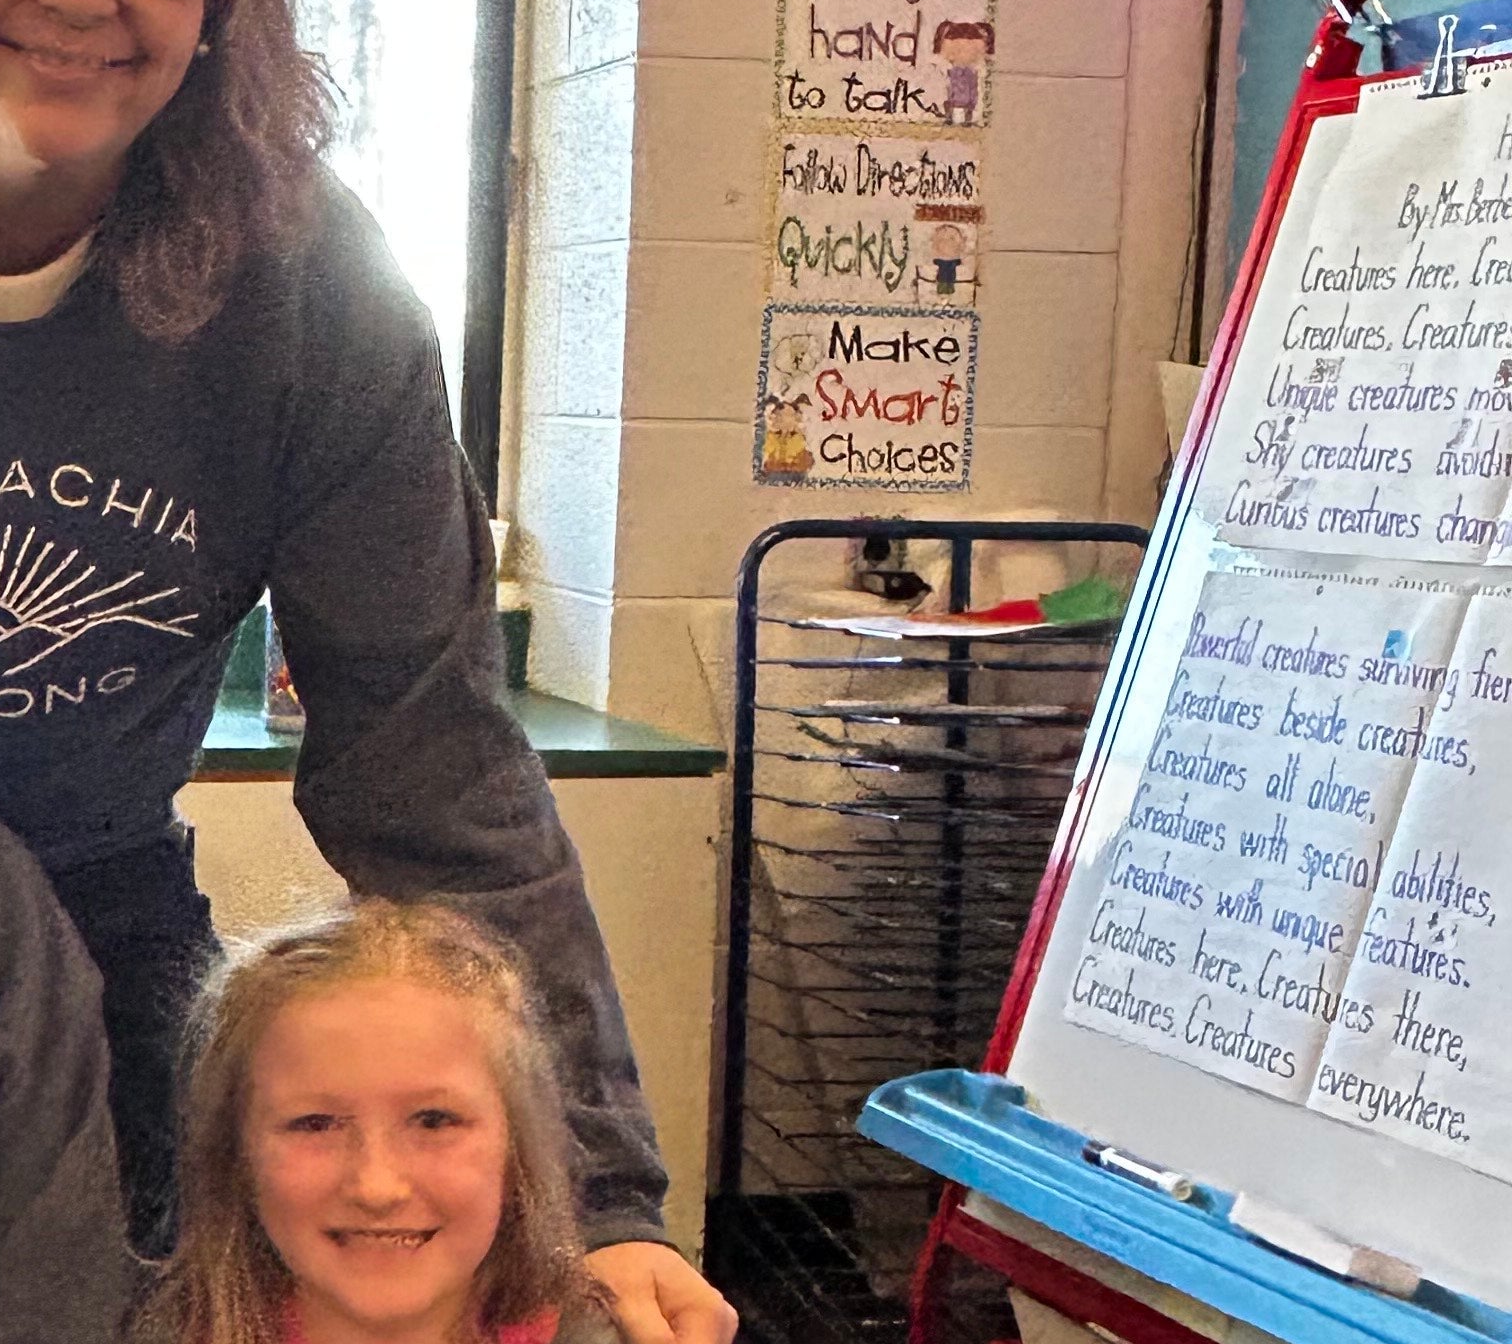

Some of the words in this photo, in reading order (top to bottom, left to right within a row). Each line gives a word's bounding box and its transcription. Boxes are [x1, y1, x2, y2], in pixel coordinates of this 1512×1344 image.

[785, 68, 826, 110] to
[1398, 183, 1429, 242] By
[777, 215, 911, 294] Quickly
[1301, 246, 1396, 293] Creatures
[828, 320, 961, 365] Make
[1348, 362, 1458, 412] creatures
[820, 432, 960, 474] Choices
[1301, 423, 1413, 474] creatures
[1318, 486, 1421, 538] creatures
[1261, 626, 1350, 679] creatures
[1358, 658, 1459, 712] surviving
[1165, 669, 1264, 731] Creatures
[1278, 686, 1347, 745] beside
[1358, 706, 1476, 776] creatures,
[1148, 723, 1247, 792] Creatures
[1265, 752, 1301, 802] all
[1129, 782, 1226, 852] Creatures
[1240, 812, 1289, 864] with
[1298, 840, 1385, 894] special
[1109, 839, 1204, 910] Creatures
[1271, 907, 1345, 955] unique
[1361, 906, 1471, 989] features.
[1089, 898, 1177, 968] Creatures
[1258, 948, 1375, 1034] Creatures
[1390, 988, 1469, 1072] there,
[1184, 993, 1296, 1080] Creatures
[1317, 1071, 1471, 1142] everywhere.
